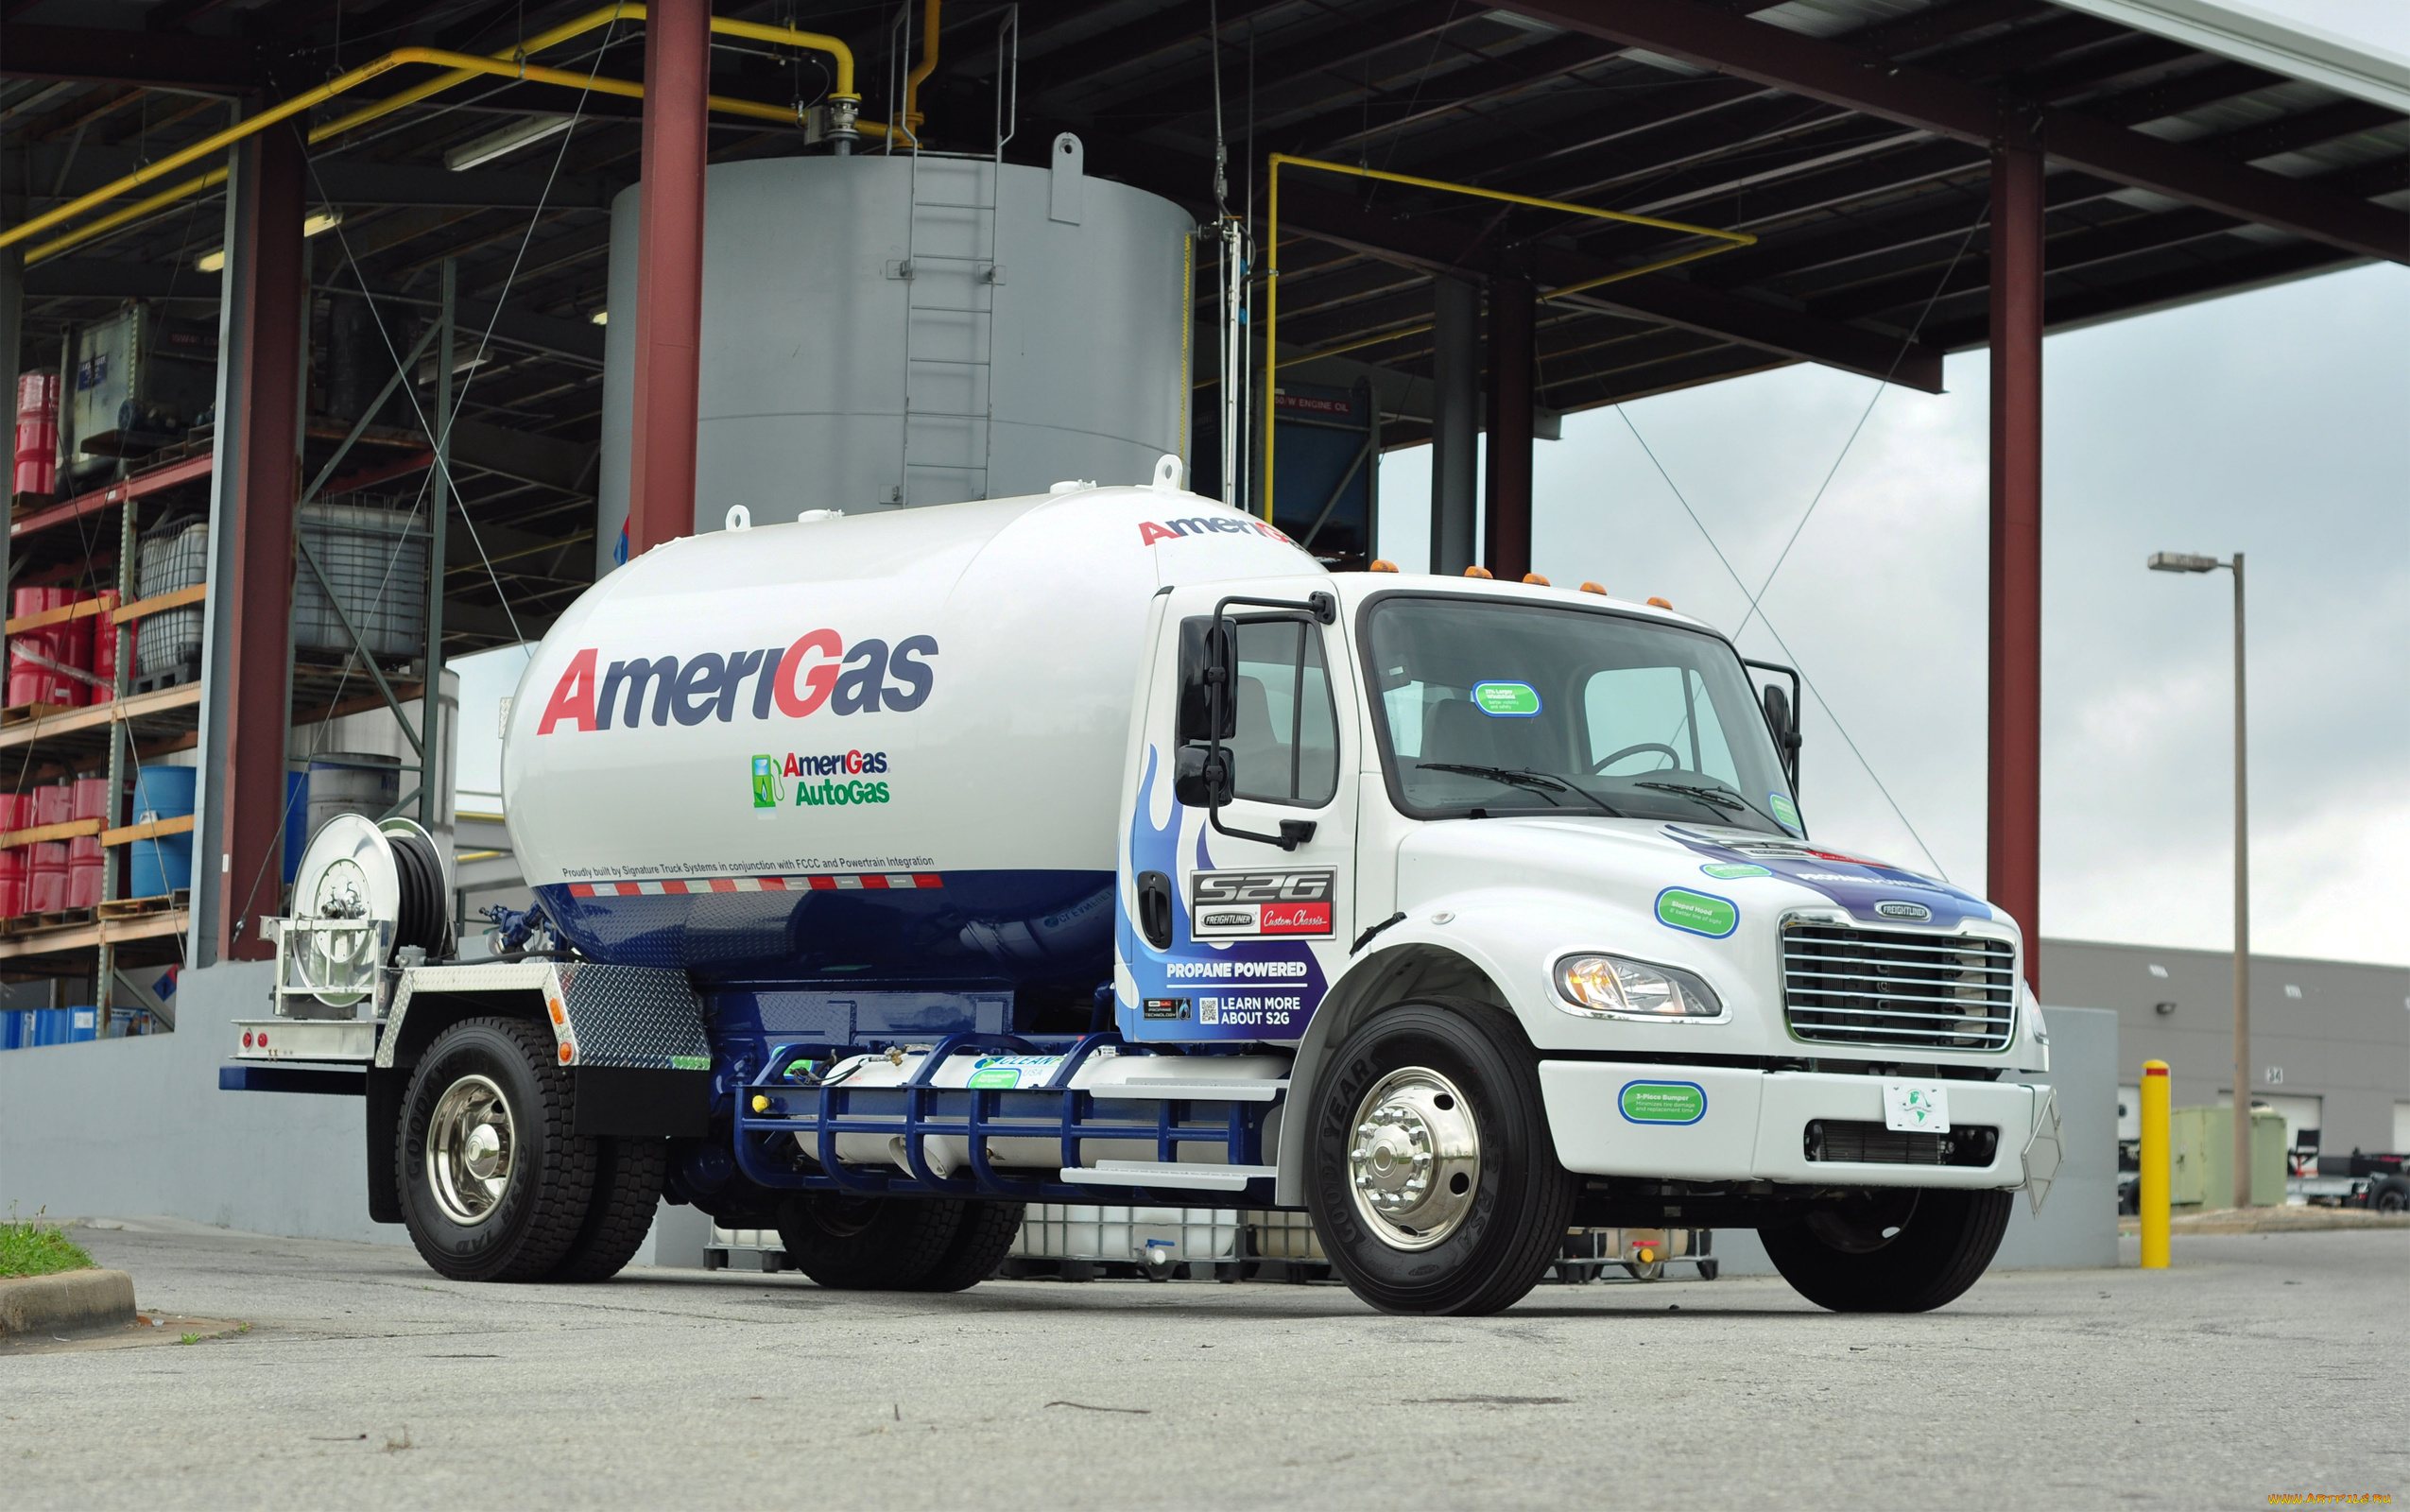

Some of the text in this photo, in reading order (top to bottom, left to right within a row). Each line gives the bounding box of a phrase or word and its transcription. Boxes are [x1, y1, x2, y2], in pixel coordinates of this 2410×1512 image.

[1299, 398, 1333, 410] ENGINE
[1334, 403, 1349, 412] OIL
[537, 627, 938, 735] AmeriGas
[783, 749, 887, 777] AmeriGas
[796, 779, 890, 806] AutoGas
[562, 855, 935, 879] Proudly built by Signature Truck Systems in conjunction with FCCC and Powertrain Integration
[1196, 873, 1331, 902] S2G
[1671, 901, 1713, 916] Sloped Hood
[1883, 905, 1926, 917] FREIGHTLINER
[1205, 909, 1328, 927] FREIGHTLINER Custom Chassis
[1692, 912, 1701, 920] line
[1709, 917, 1722, 926] sight
[1166, 961, 1308, 979] PROPANE POWERED
[1221, 997, 1300, 1011] LEARN MORE
[1221, 1011, 1290, 1025] ABOUT S2G
[1023, 1068, 1042, 1077] USA
